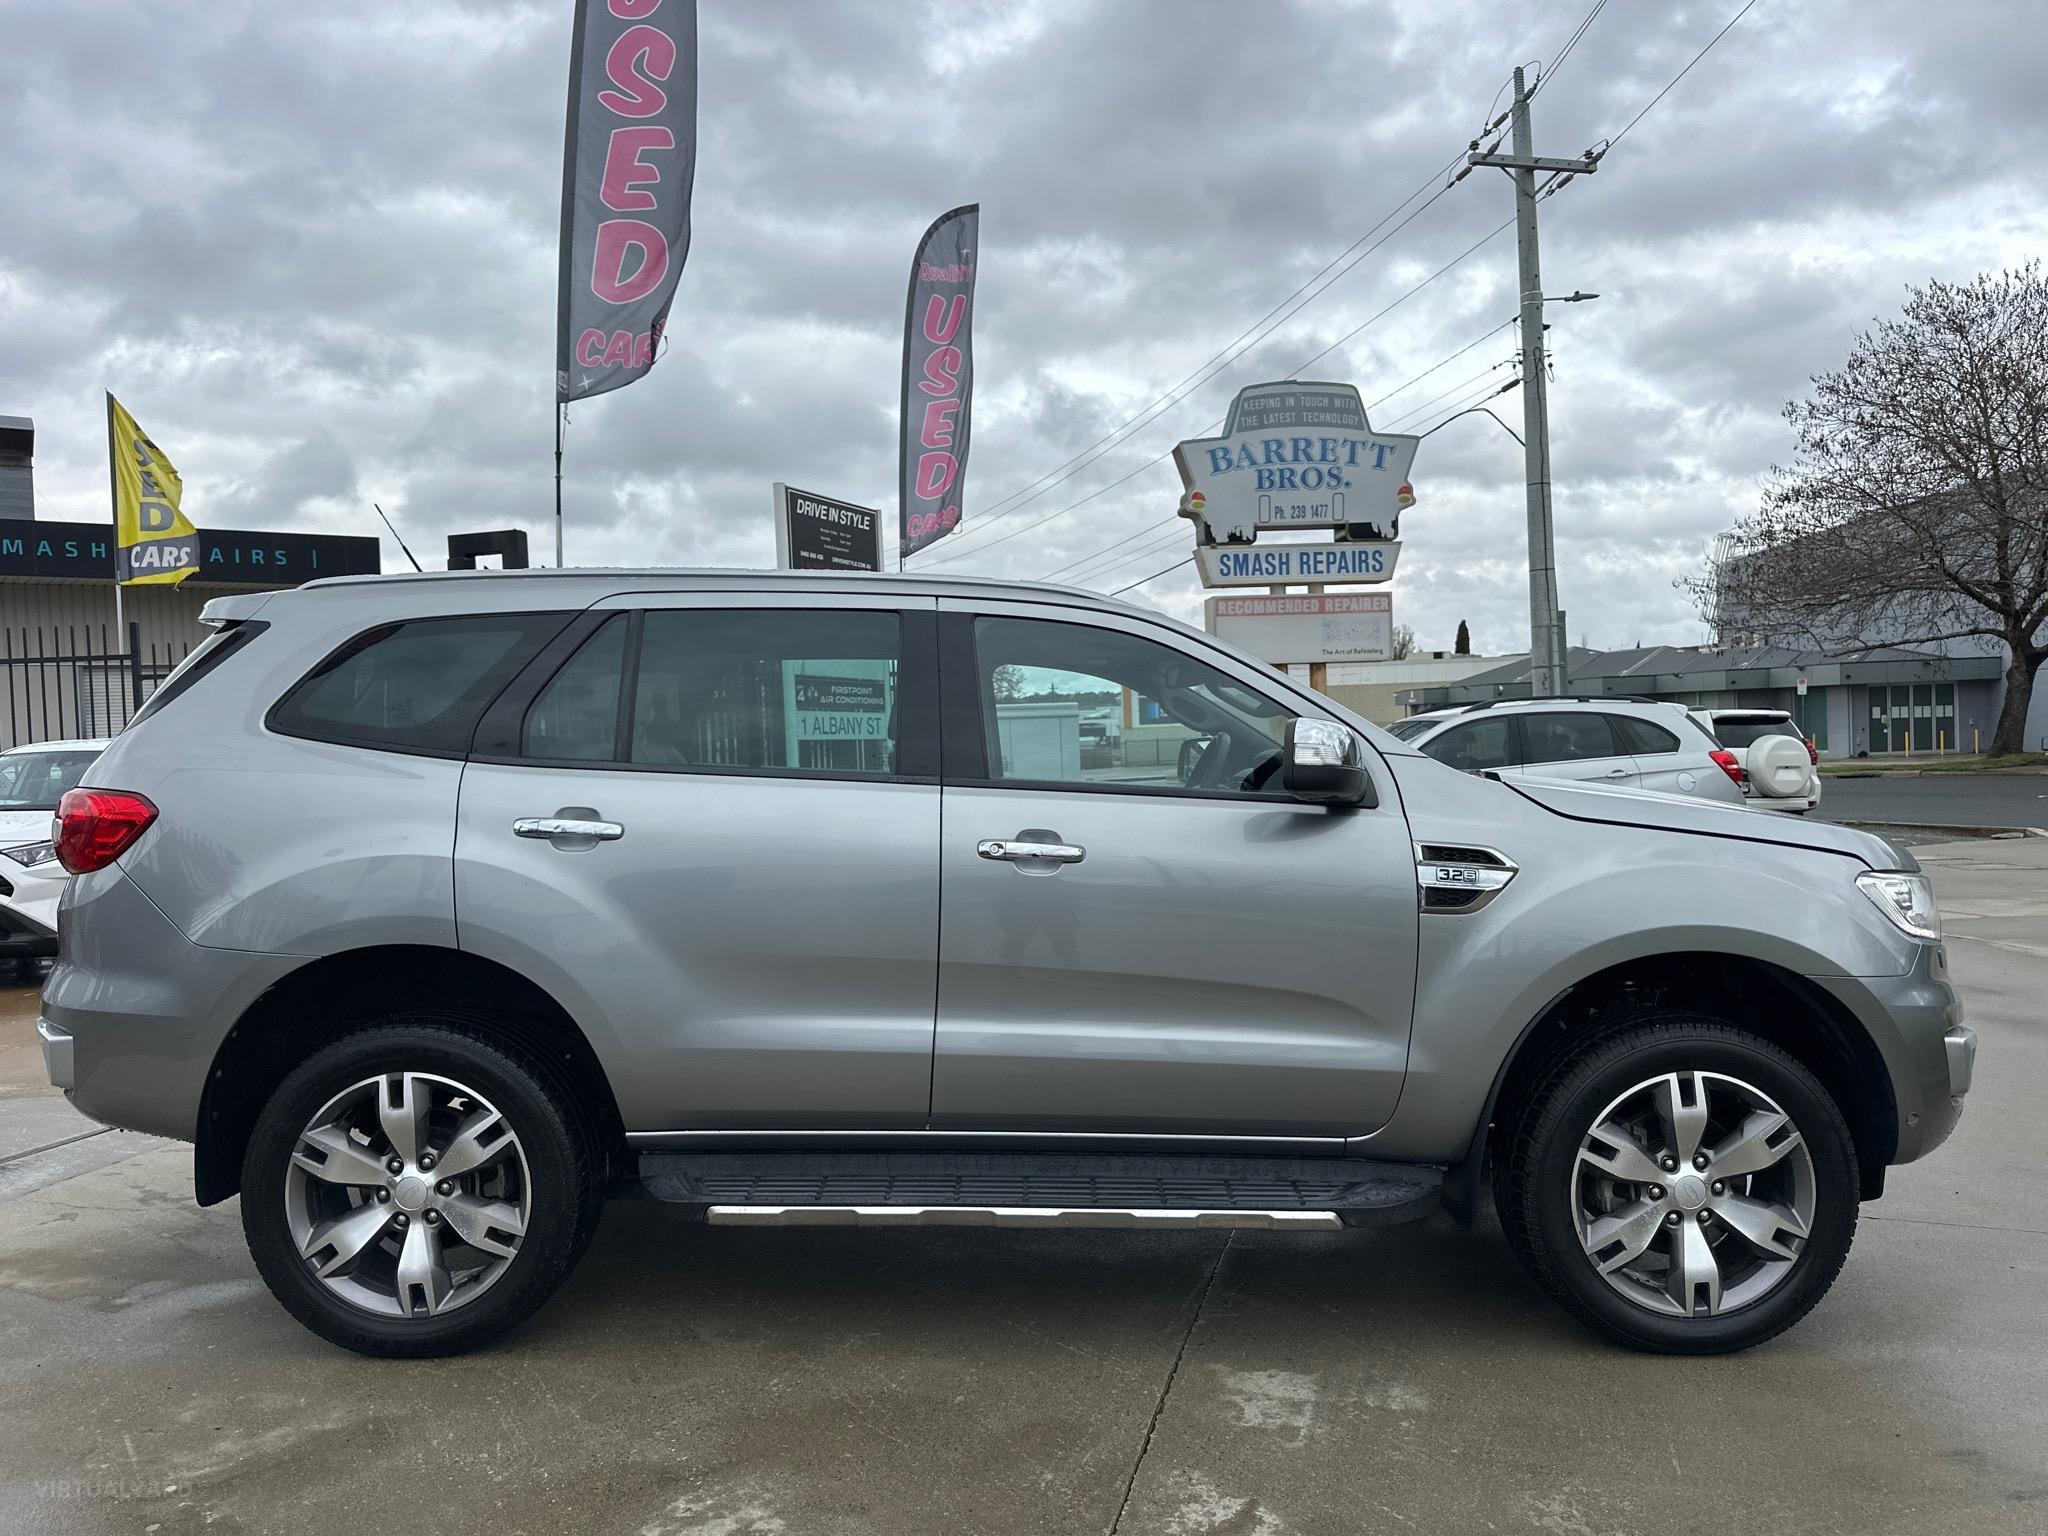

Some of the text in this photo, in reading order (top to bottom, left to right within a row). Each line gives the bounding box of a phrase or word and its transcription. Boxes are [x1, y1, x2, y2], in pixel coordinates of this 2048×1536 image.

[576, 328, 655, 369] CAR
[915, 294, 967, 500] USED
[1243, 396, 1356, 411] KEEPING IN TOUCH WITH
[1240, 411, 1360, 427] THE LATEST TECHNOLOGY
[1207, 436, 1398, 476] BARRETT
[1254, 465, 1353, 492] BROS.
[796, 498, 871, 530] DRIVE IN STYLE
[907, 505, 958, 537] CARS
[1274, 503, 1329, 520] Ph. 239 1477
[130, 545, 191, 568] CARS
[1219, 549, 1384, 577] SMASH REPAIRS
[1217, 595, 1389, 615] RECOMMENDED REPAIRER
[1353, 647, 1384, 655] Refinishing
[820, 695, 884, 705] AIR CONDITIONING
[831, 685, 873, 695] FIRSTPOINT
[801, 716, 882, 736] 1 ALBANY ST
